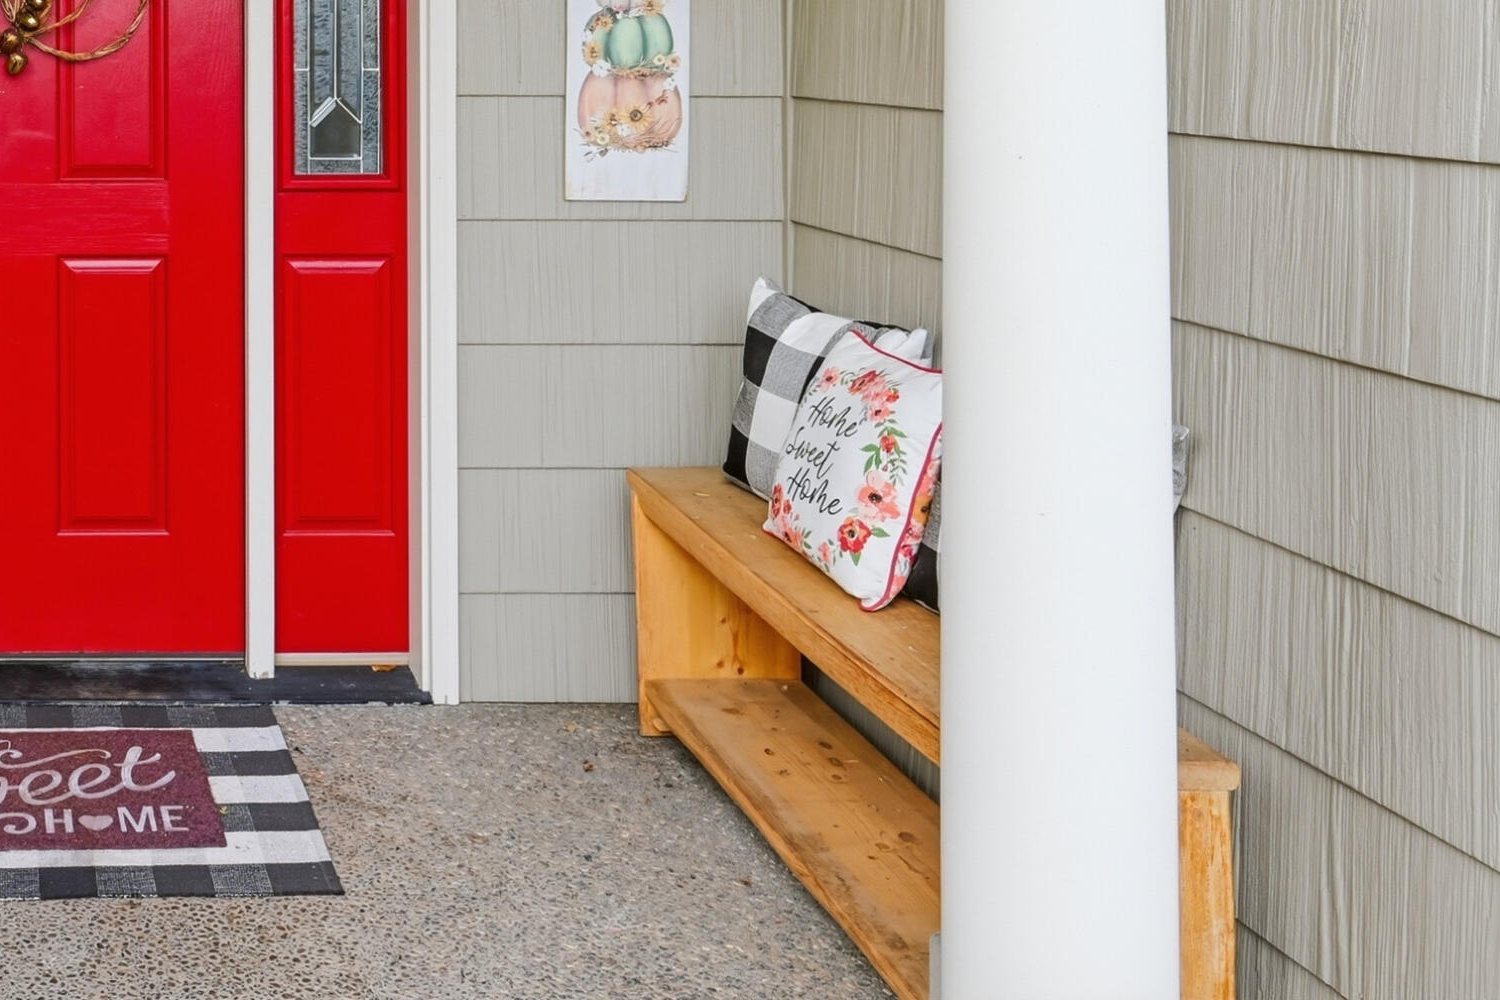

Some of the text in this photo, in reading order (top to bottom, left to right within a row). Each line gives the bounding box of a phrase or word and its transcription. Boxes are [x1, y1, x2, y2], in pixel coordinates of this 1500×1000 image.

[808, 396, 858, 437] Home
[785, 426, 841, 479] Sweet
[787, 467, 843, 515] Home
